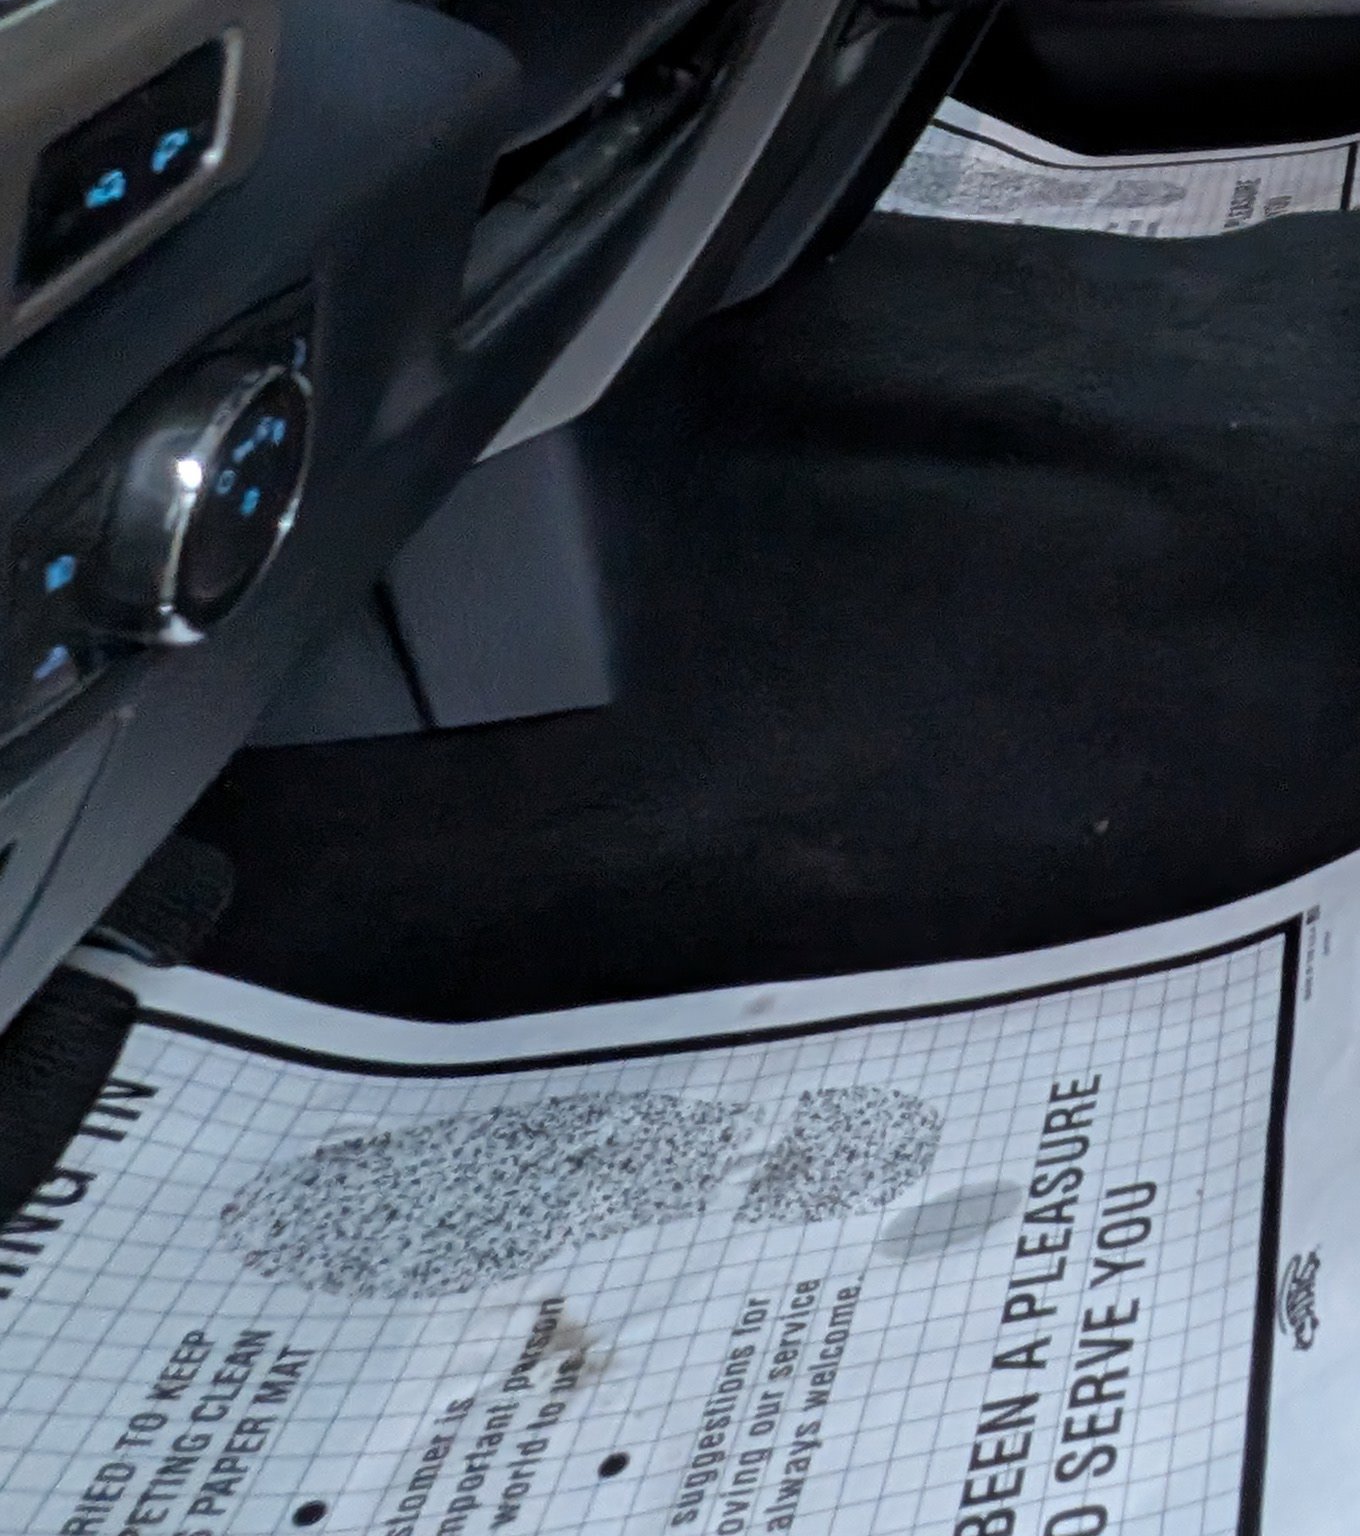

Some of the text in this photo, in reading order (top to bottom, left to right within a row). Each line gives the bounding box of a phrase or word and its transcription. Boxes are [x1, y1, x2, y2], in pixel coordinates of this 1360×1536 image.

[953, 1073, 1103, 1536] BEEN A PLEASURE
[1089, 1180, 1158, 1293] YOU
[114, 1412, 168, 1450] TO
[146, 1329, 215, 1400] KEEP
[191, 1330, 275, 1422] CLEAN
[434, 1396, 474, 1426] is
[503, 1297, 566, 1393] person
[671, 1297, 770, 1528] suggestions for
[717, 1278, 822, 1536] oving our service
[764, 1275, 865, 1533] always welcome.
[1054, 1298, 1140, 1487] SERVE
[187, 1416, 277, 1515] PAPER
[253, 1344, 316, 1403] MAT
[490, 1436, 549, 1529] world
[526, 1401, 566, 1431] to
